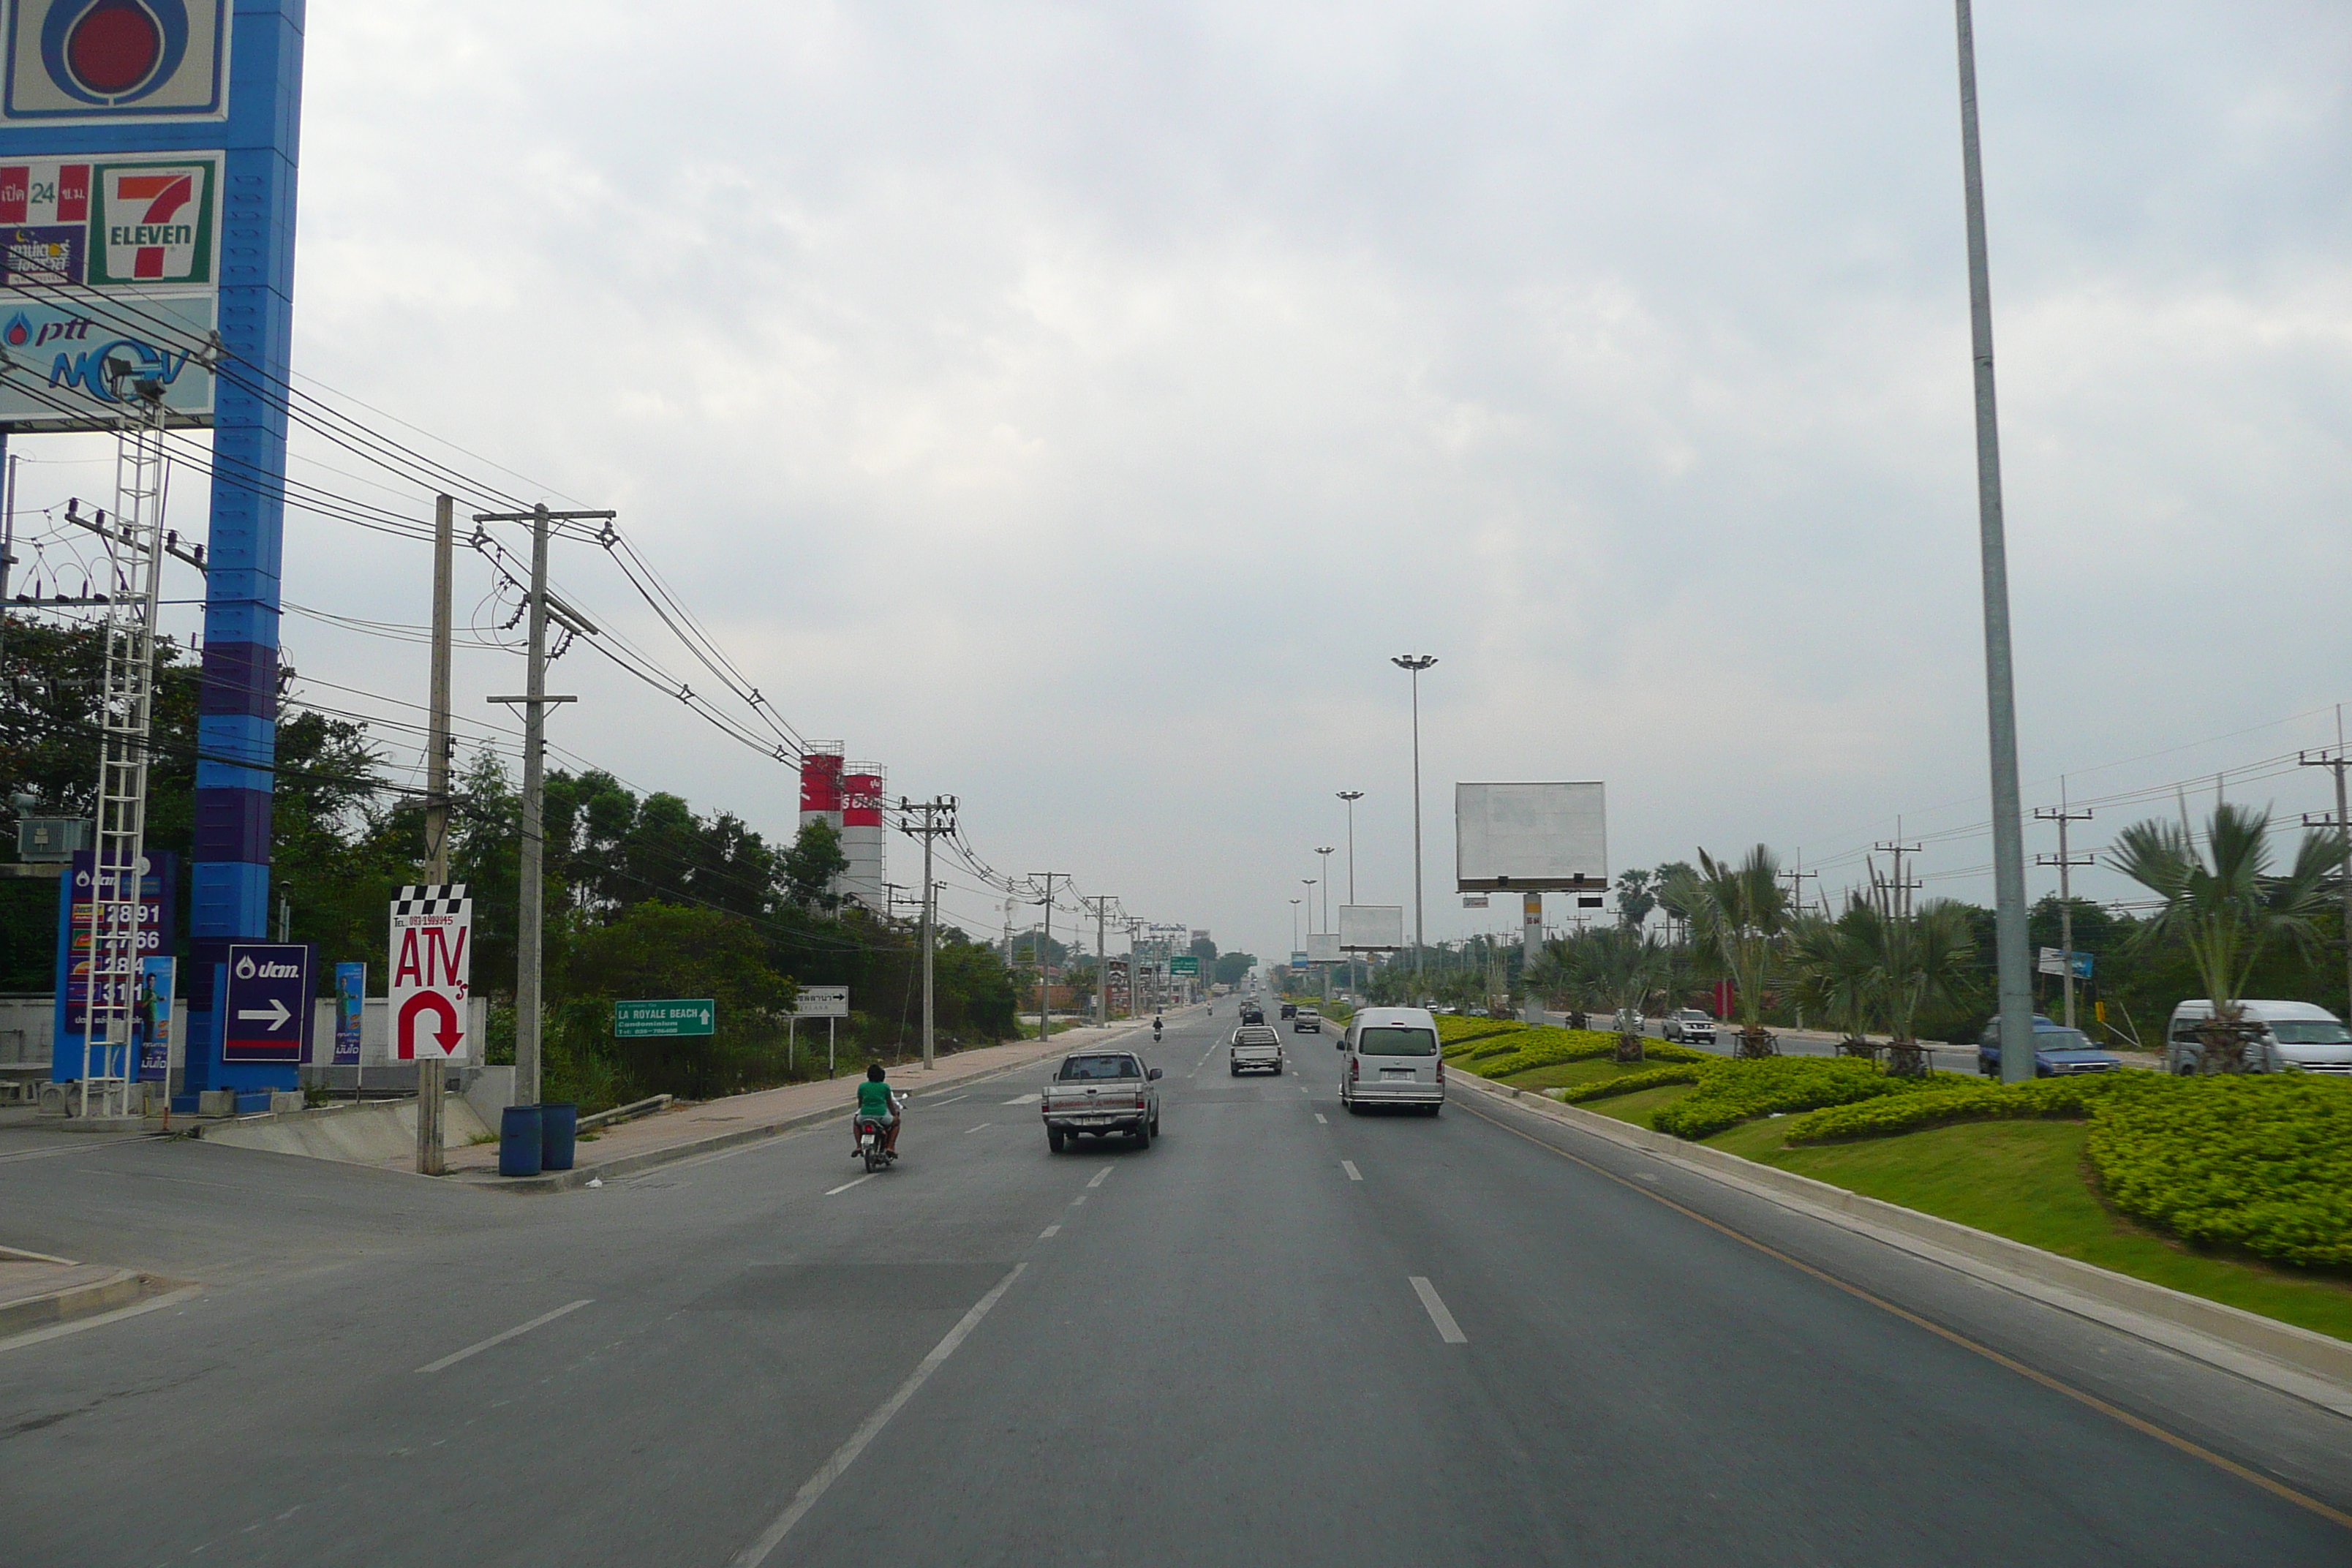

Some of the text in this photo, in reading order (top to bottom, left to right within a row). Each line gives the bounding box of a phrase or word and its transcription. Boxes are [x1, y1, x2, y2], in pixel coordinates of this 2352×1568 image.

[31, 182, 56, 203] 24
[117, 175, 192, 278] 7
[35, 317, 94, 347] ptt
[258, 961, 299, 978] ปตท.
[618, 1009, 698, 1019] LA ROYALE BEACH
